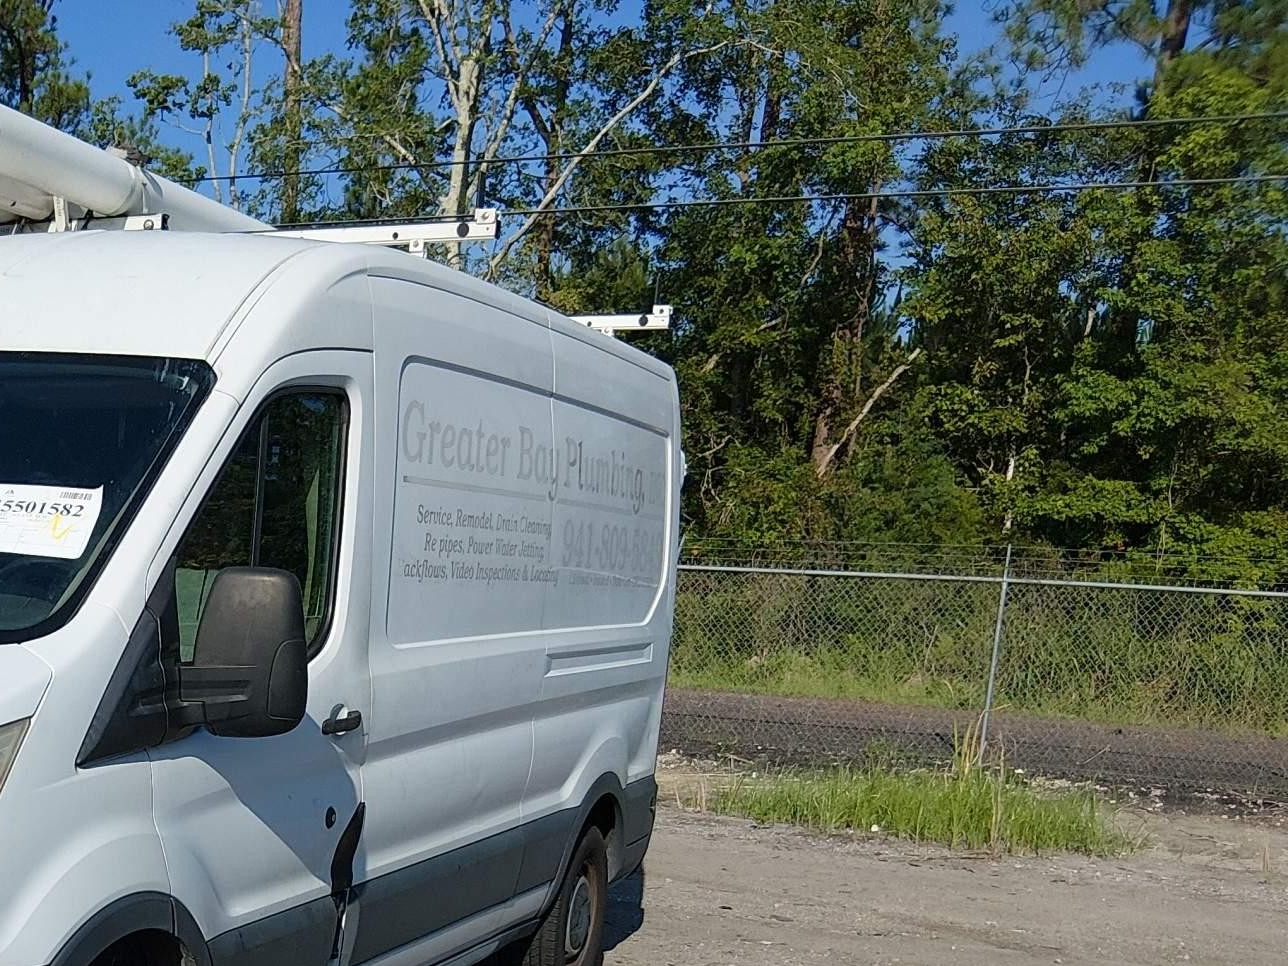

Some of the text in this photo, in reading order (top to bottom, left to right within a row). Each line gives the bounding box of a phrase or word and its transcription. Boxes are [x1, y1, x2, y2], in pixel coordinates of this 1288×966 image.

[402, 399, 511, 476] Greater
[517, 424, 559, 501] Bay
[416, 504, 453, 528] Service,
[495, 513, 518, 532] Drain
[423, 532, 436, 552] Re
[439, 534, 465, 558] pipes,
[467, 536, 493, 555] Power
[495, 538, 517, 558] Water
[451, 561, 474, 580] Video
[475, 562, 520, 585] Inspections
[521, 564, 529, 581] &
[530, 565, 559, 587] Locating
